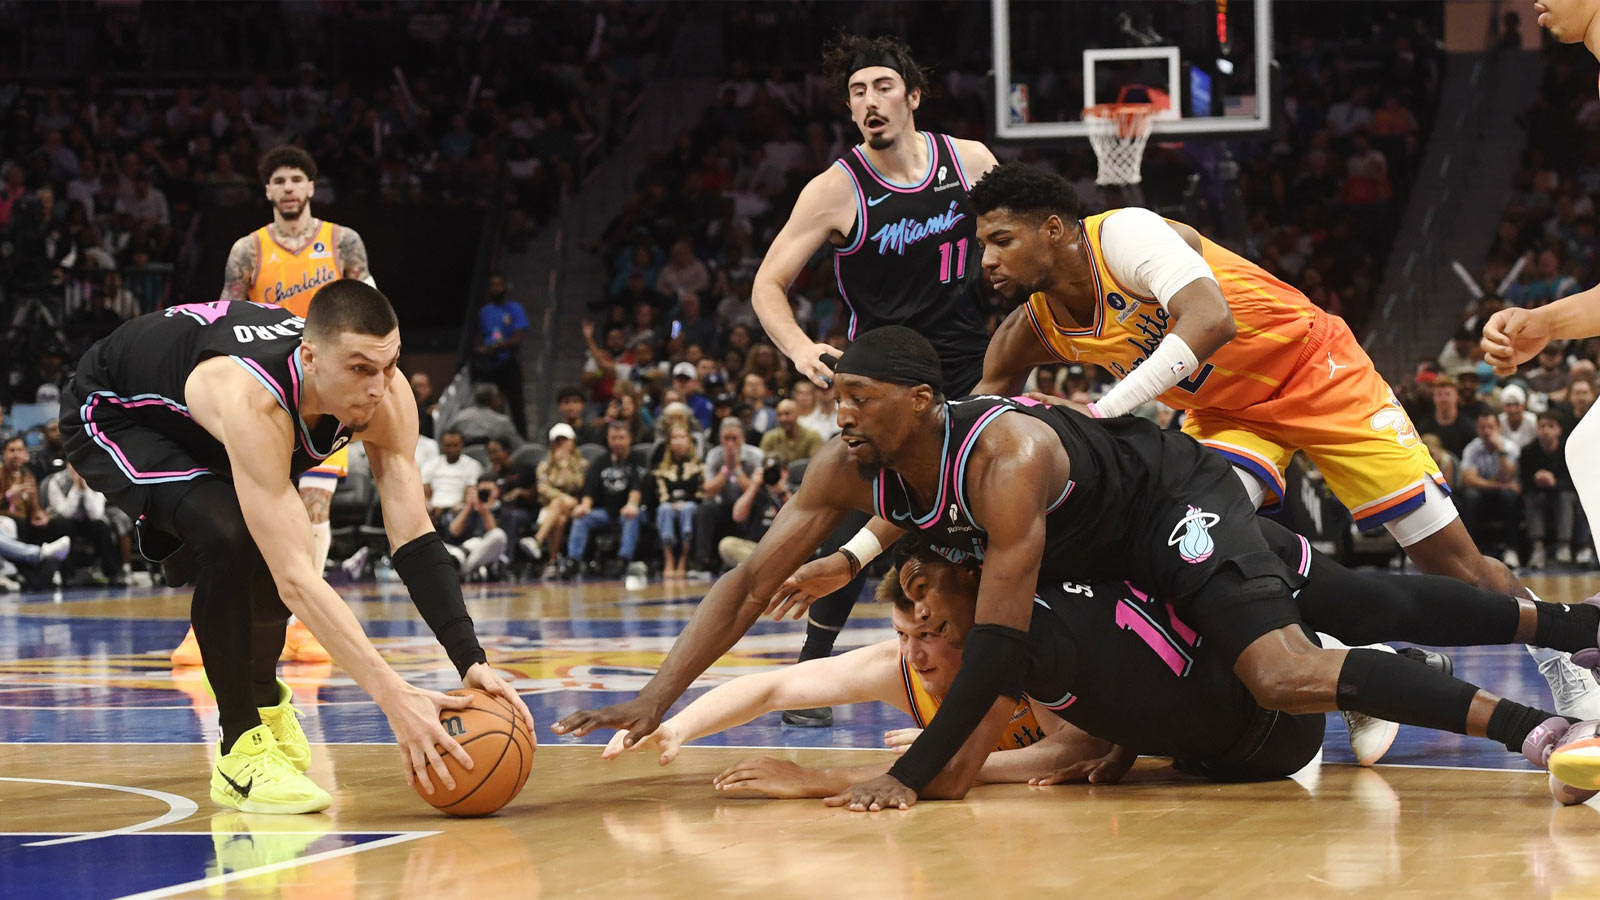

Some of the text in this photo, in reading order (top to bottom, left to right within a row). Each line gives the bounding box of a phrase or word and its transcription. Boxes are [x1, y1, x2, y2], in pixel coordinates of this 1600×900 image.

[870, 200, 966, 256] Miami
[939, 237, 968, 284] 11
[264, 265, 334, 305] Charlotte
